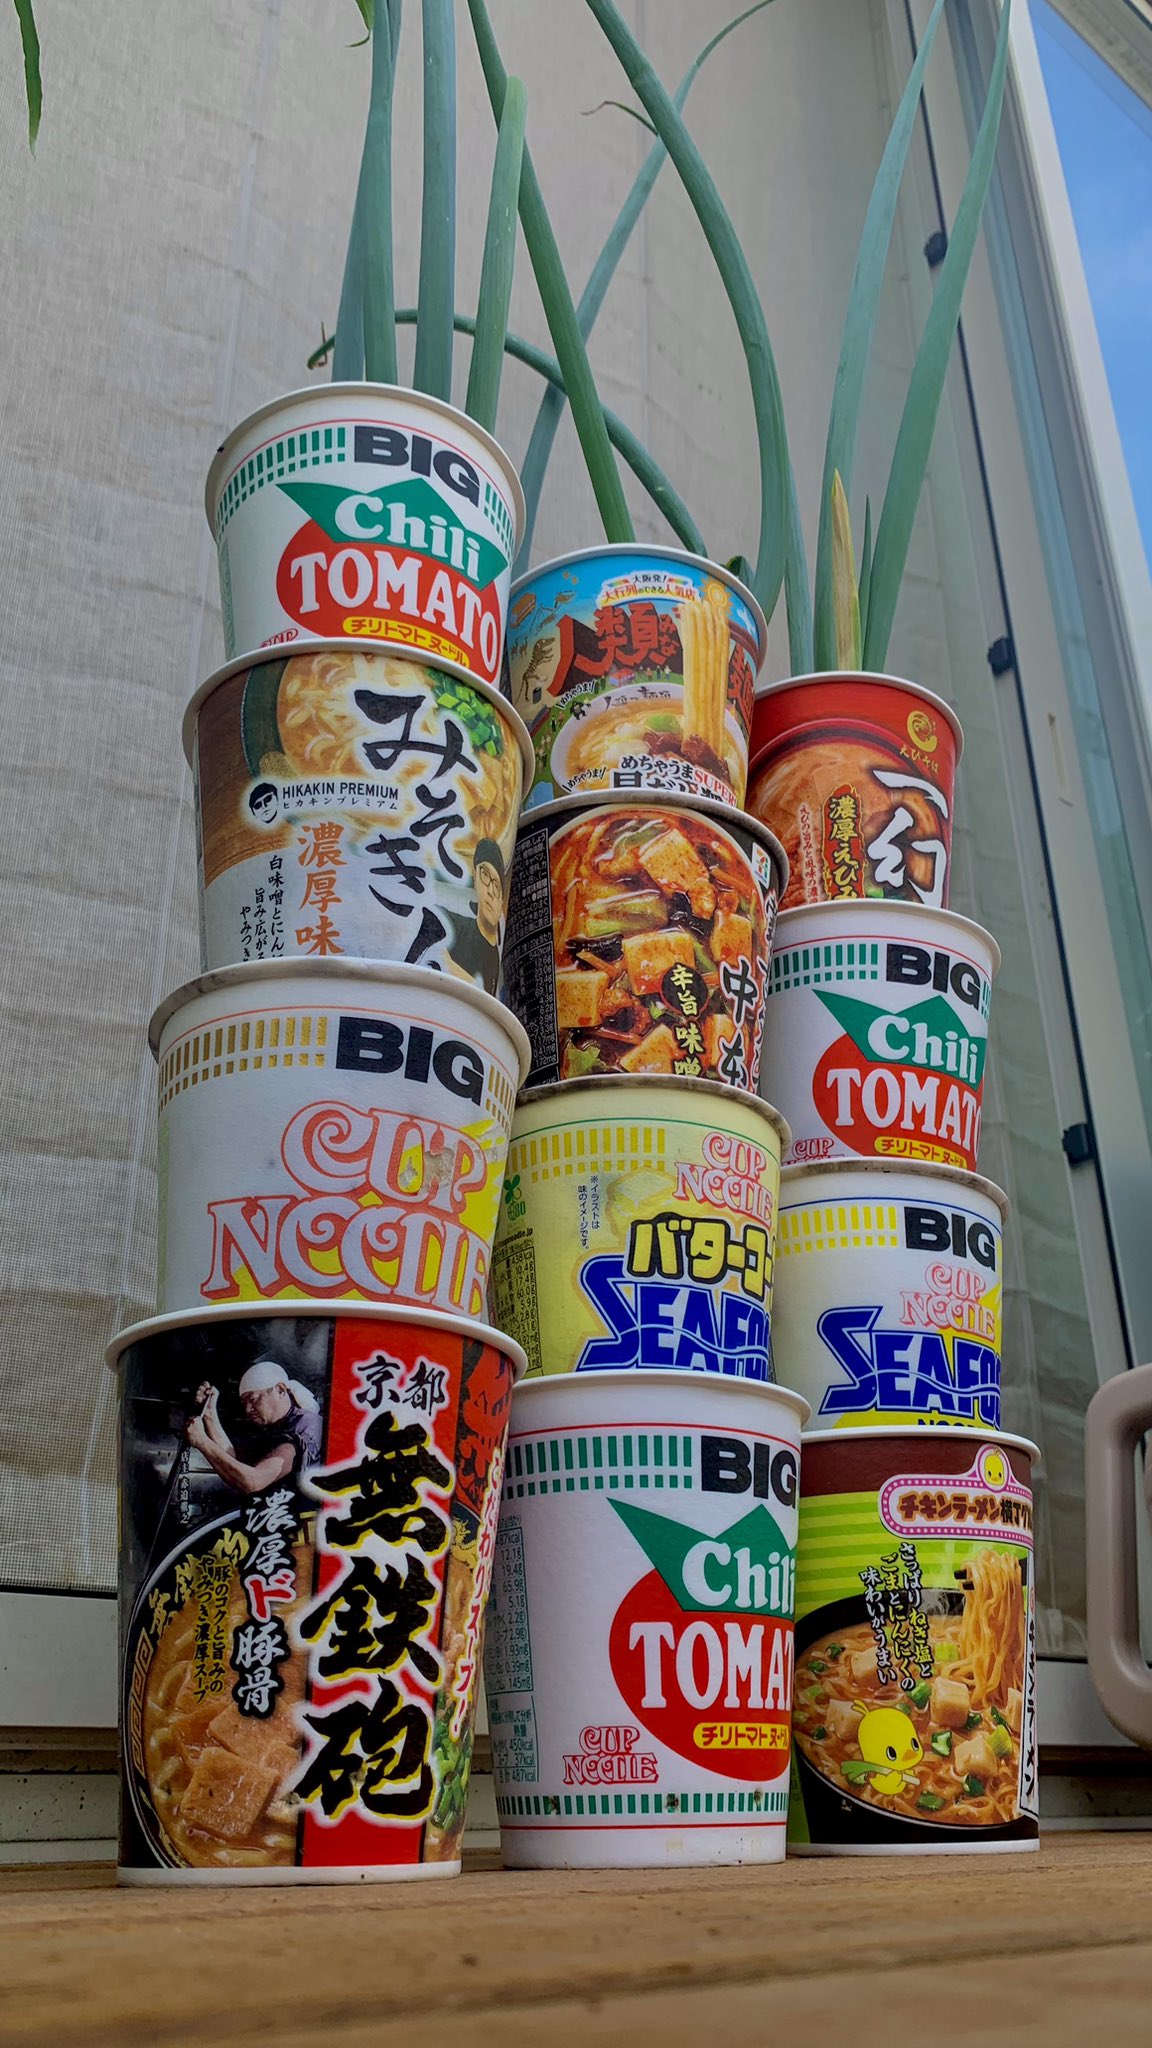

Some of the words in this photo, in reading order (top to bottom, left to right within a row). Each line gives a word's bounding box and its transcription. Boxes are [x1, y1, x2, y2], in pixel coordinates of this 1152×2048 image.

[354, 425, 480, 507] BIG
[334, 495, 481, 581] Chili
[290, 547, 498, 673] TOMATO
[603, 583, 697, 603] 大行列のできる人気店
[283, 782, 335, 799] HIKAKIN
[340, 782, 399, 800] PREMIUM
[283, 796, 398, 810] ヒカキンプレミアム
[268, 855, 285, 958] 白味噌とにん
[296, 823, 347, 956] 濃厚味
[886, 943, 981, 1011] BIG
[336, 1015, 485, 1107] BIG
[867, 1014, 978, 1085] Chili
[281, 1100, 487, 1214] CUP
[702, 1131, 767, 1180] CUP
[792, 1138, 834, 1159] CUP
[673, 1161, 773, 1229] NOODLE
[904, 1206, 996, 1272] BIG
[900, 1290, 995, 1343] NOODLE
[925, 1262, 987, 1299] CUP
[356, 1354, 447, 1417] 京都
[700, 1435, 797, 1507] BIG
[236, 1492, 297, 1713] 濃厚ド豚骨
[295, 1410, 453, 1819] 無鉄砲
[682, 1540, 795, 1617] Chili
[193, 1557, 216, 1704] やみつき濃厚スープ
[209, 1563, 232, 1694] 豚のコクと旨みの
[860, 1566, 897, 1685] 味わいがうまい
[881, 1552, 915, 1691] ごまとにんにくの
[562, 1751, 659, 1785] NOODLE
[578, 1725, 641, 1755] CUP
